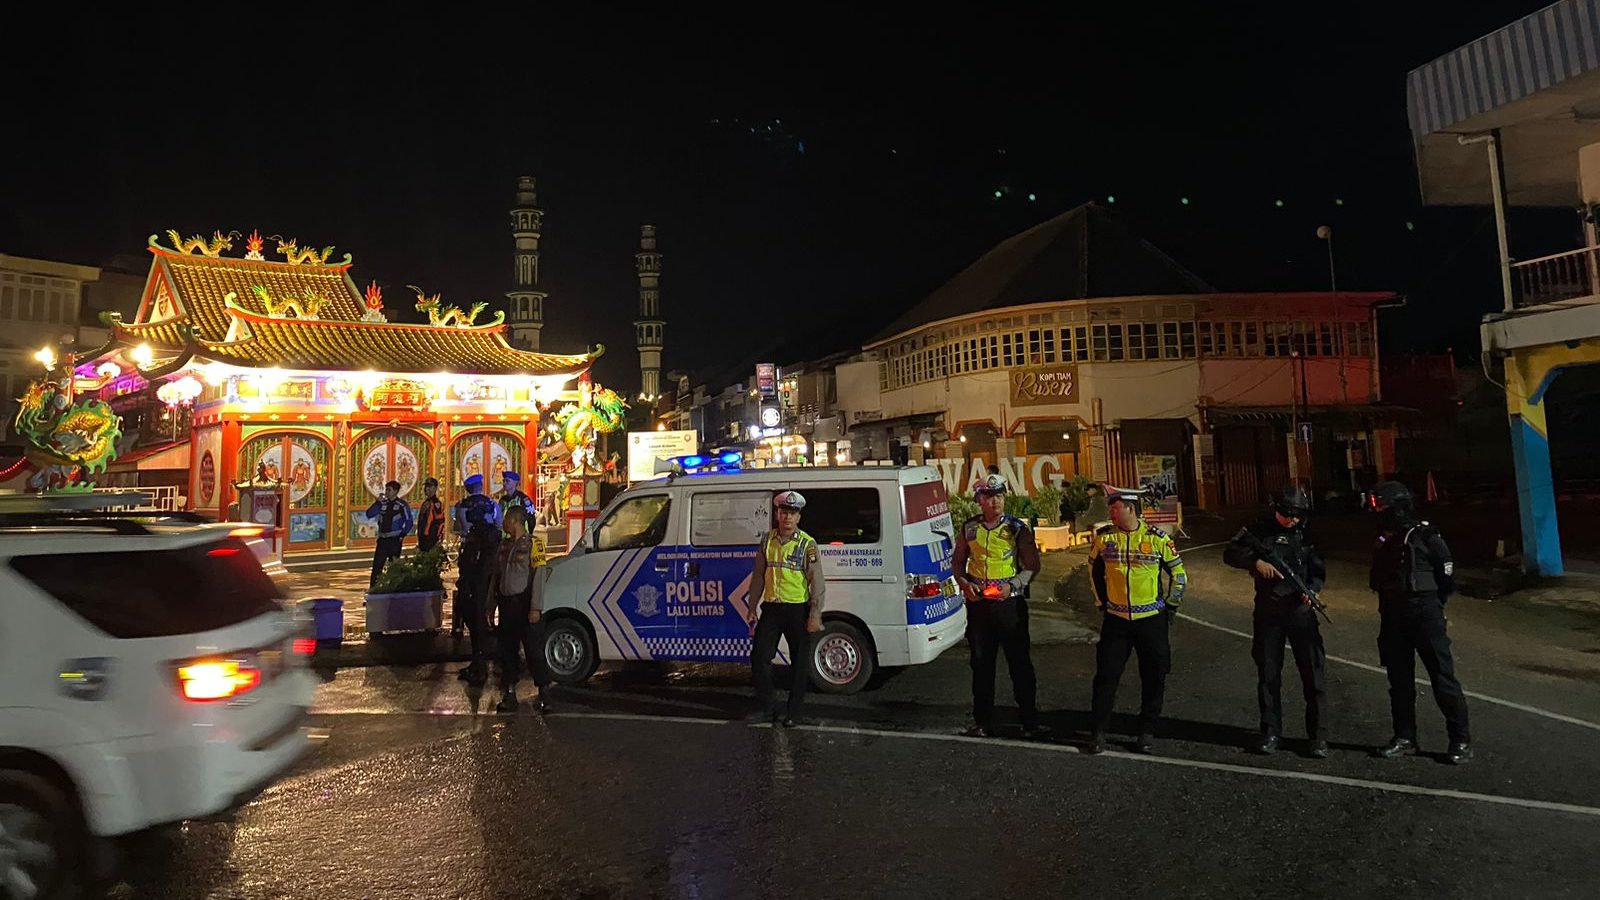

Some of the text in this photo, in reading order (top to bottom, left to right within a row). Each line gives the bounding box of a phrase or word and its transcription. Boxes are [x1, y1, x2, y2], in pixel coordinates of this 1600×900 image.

[1039, 372, 1072, 381] KOPI TIAM
[1013, 371, 1073, 401] Rusen
[665, 580, 724, 604] POLISI
[667, 604, 726, 617] LALU LINTAS
